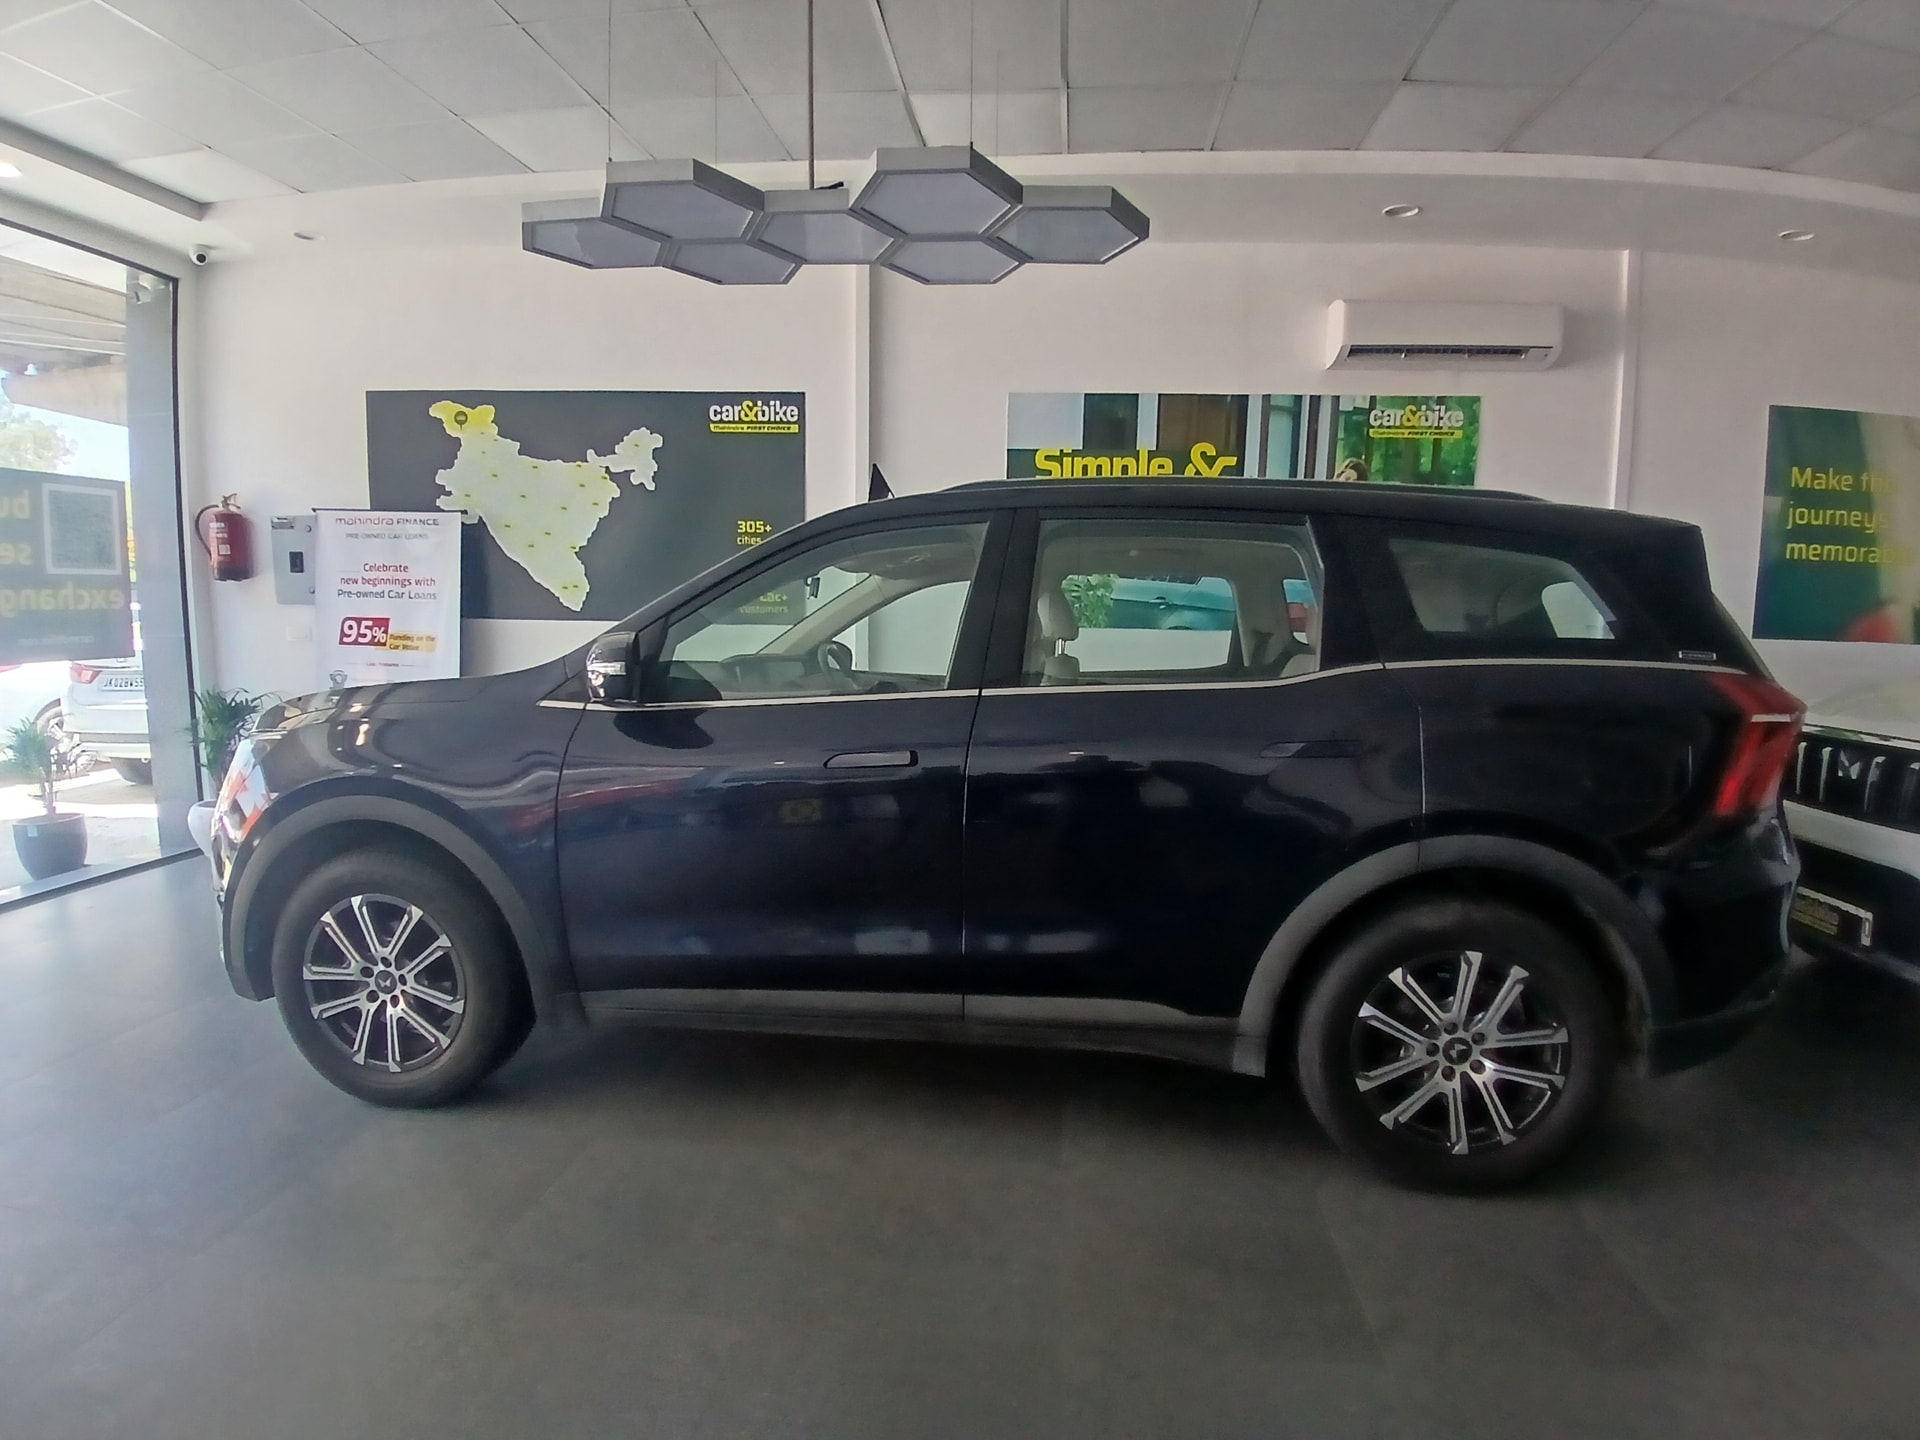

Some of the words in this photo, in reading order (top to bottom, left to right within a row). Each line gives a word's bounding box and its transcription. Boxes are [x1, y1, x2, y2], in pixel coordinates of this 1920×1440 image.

[709, 400, 799, 422] car&bike
[1369, 404, 1464, 428] car&bike
[1791, 466, 1853, 492] Make
[335, 516, 394, 526] mahindra
[396, 517, 440, 526] FINANCE
[737, 520, 772, 533] 305+
[737, 535, 762, 545] cities
[1786, 542, 1908, 564] memorab
[363, 563, 409, 573] Celebrate
[340, 577, 359, 585] new
[361, 576, 412, 588] beginnings
[414, 578, 436, 587] with
[337, 589, 385, 599] Pre-owned
[387, 590, 405, 599] Car
[408, 590, 437, 600] Loans
[342, 619, 387, 643] 95%
